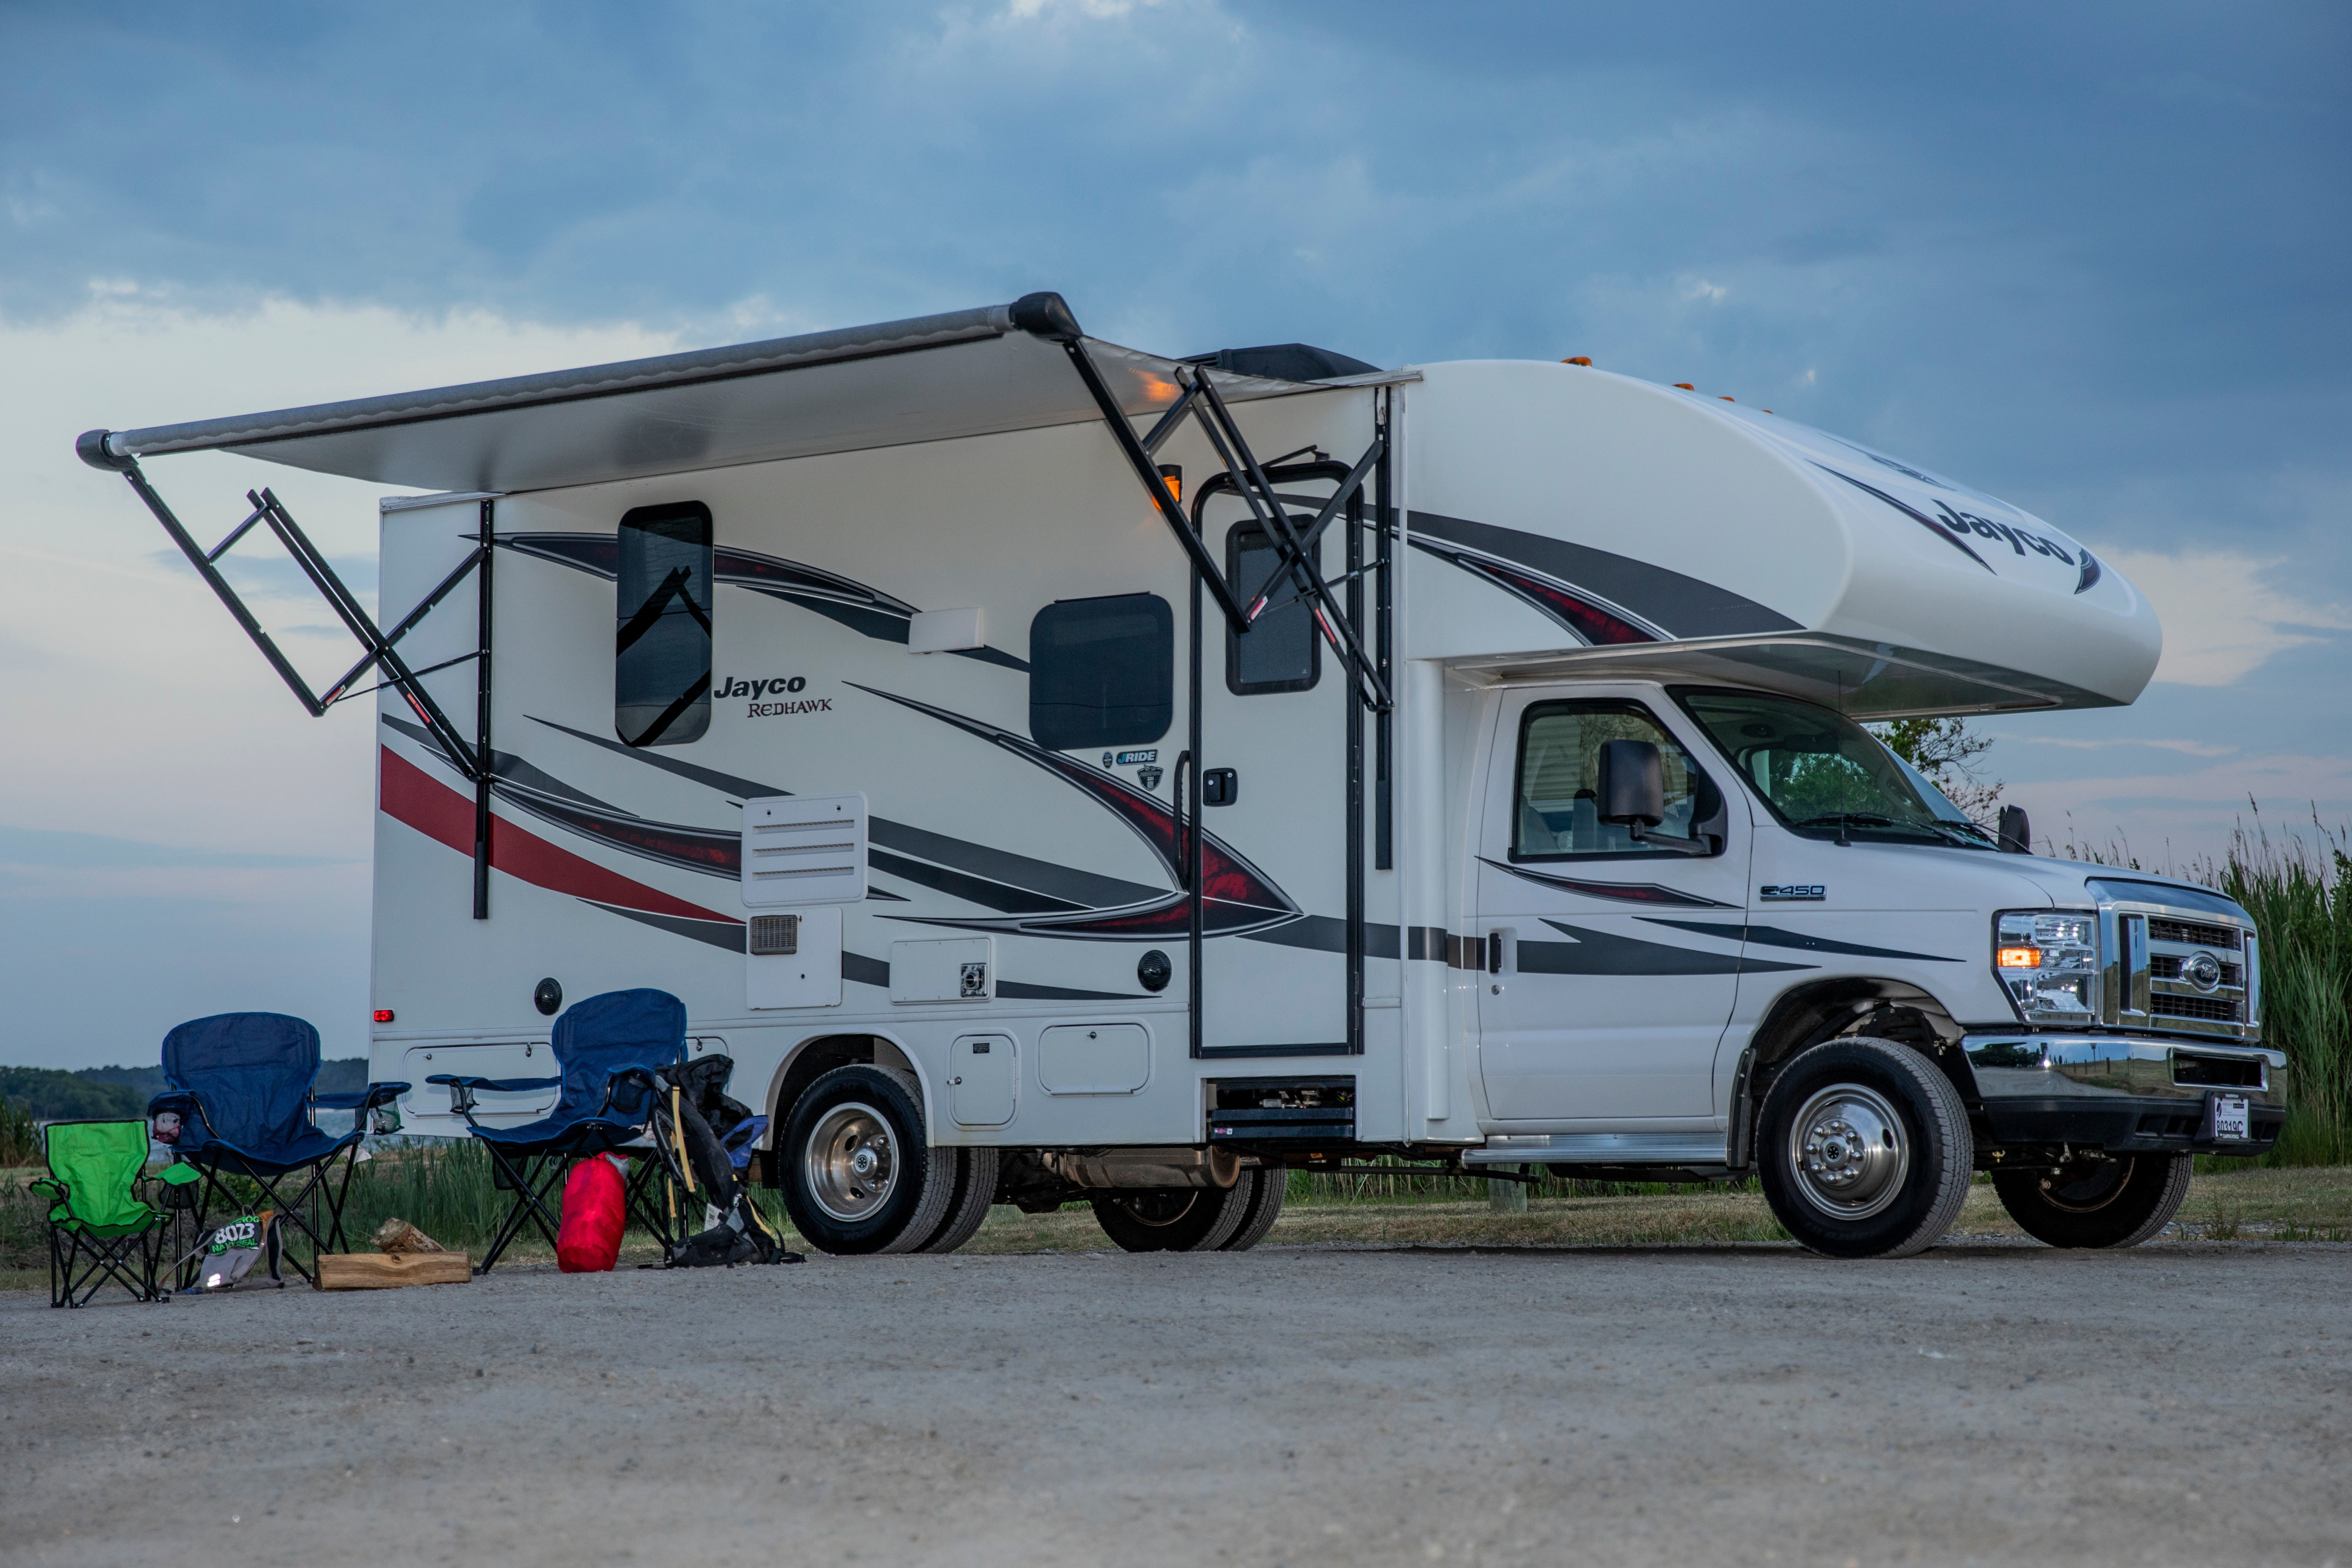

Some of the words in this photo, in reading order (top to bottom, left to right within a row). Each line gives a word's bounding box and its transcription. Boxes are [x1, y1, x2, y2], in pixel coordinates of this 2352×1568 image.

[1930, 499, 2074, 566] Jayco
[714, 676, 806, 701] Jayco
[2201, 964, 2216, 979] Ford
[215, 1223, 255, 1244] 8023
